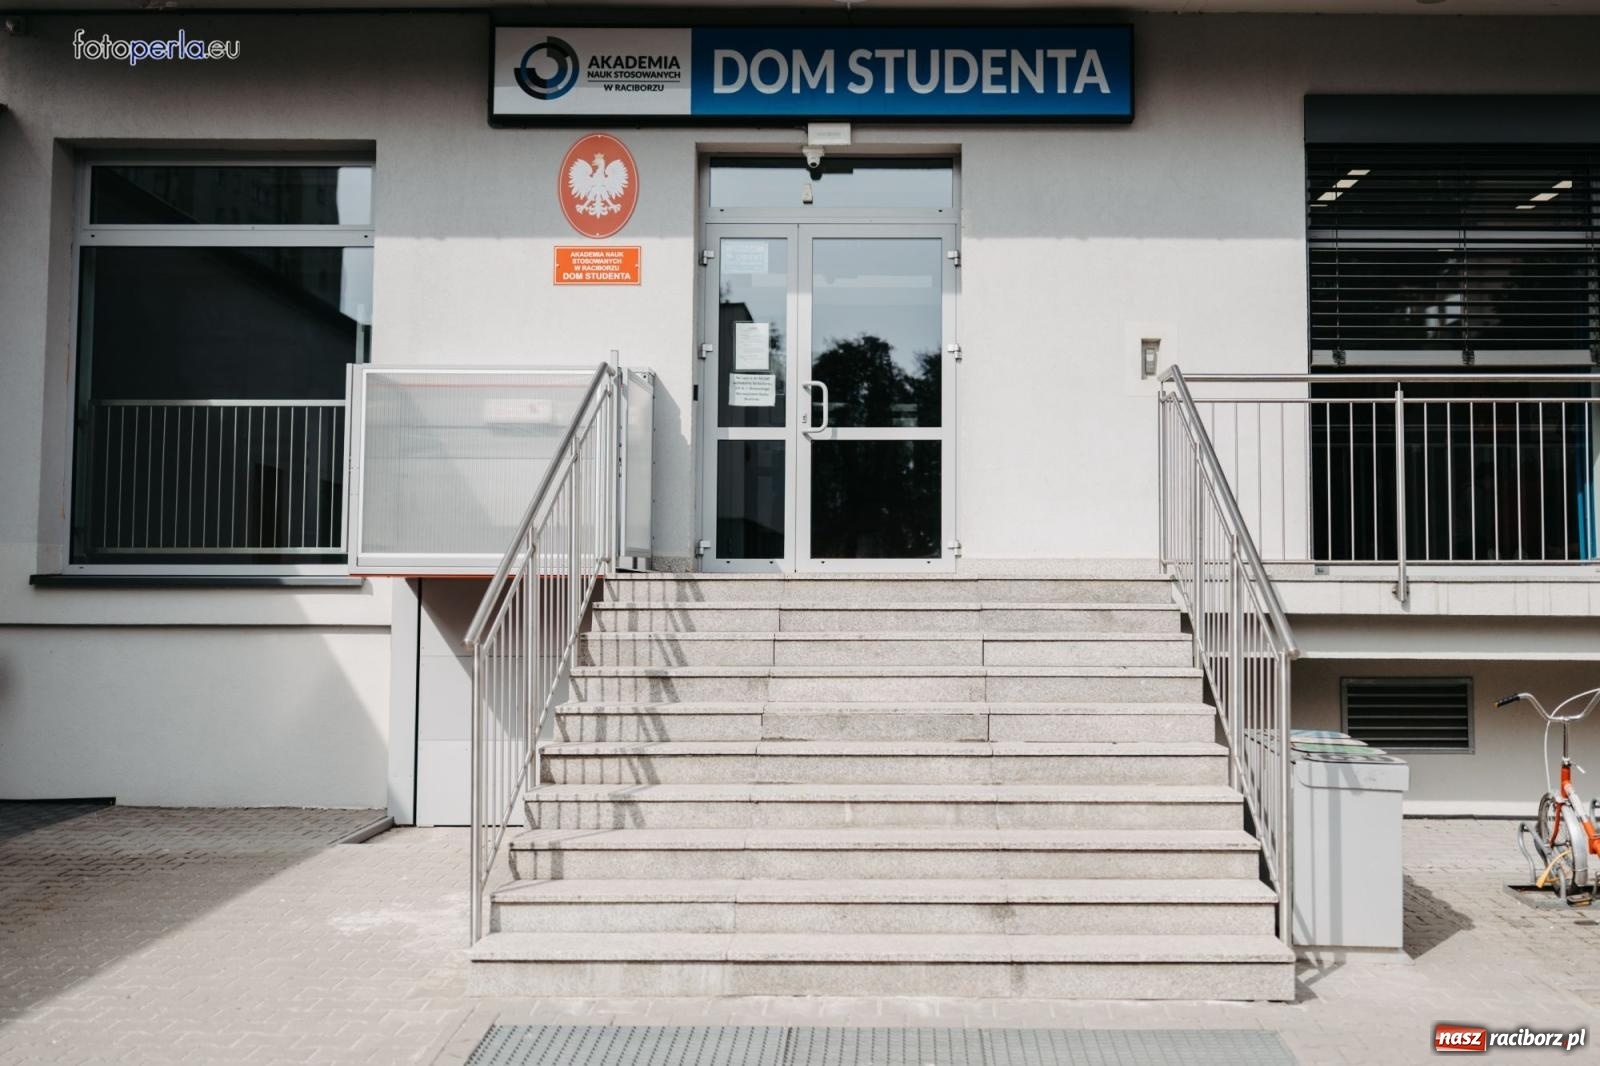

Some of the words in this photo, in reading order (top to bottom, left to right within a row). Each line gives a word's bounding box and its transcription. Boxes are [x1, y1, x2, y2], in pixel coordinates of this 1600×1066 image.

[587, 55, 681, 69] AKADEMIA
[587, 70, 613, 79] NAUK
[613, 70, 681, 79] STOSOWANYCH
[713, 49, 835, 95] DOM
[847, 48, 1111, 95] STUDENTA
[604, 84, 613, 92] W
[615, 84, 664, 92] RACIBORZU
[563, 272, 583, 280] DOM
[585, 272, 631, 280] STUDENTA
